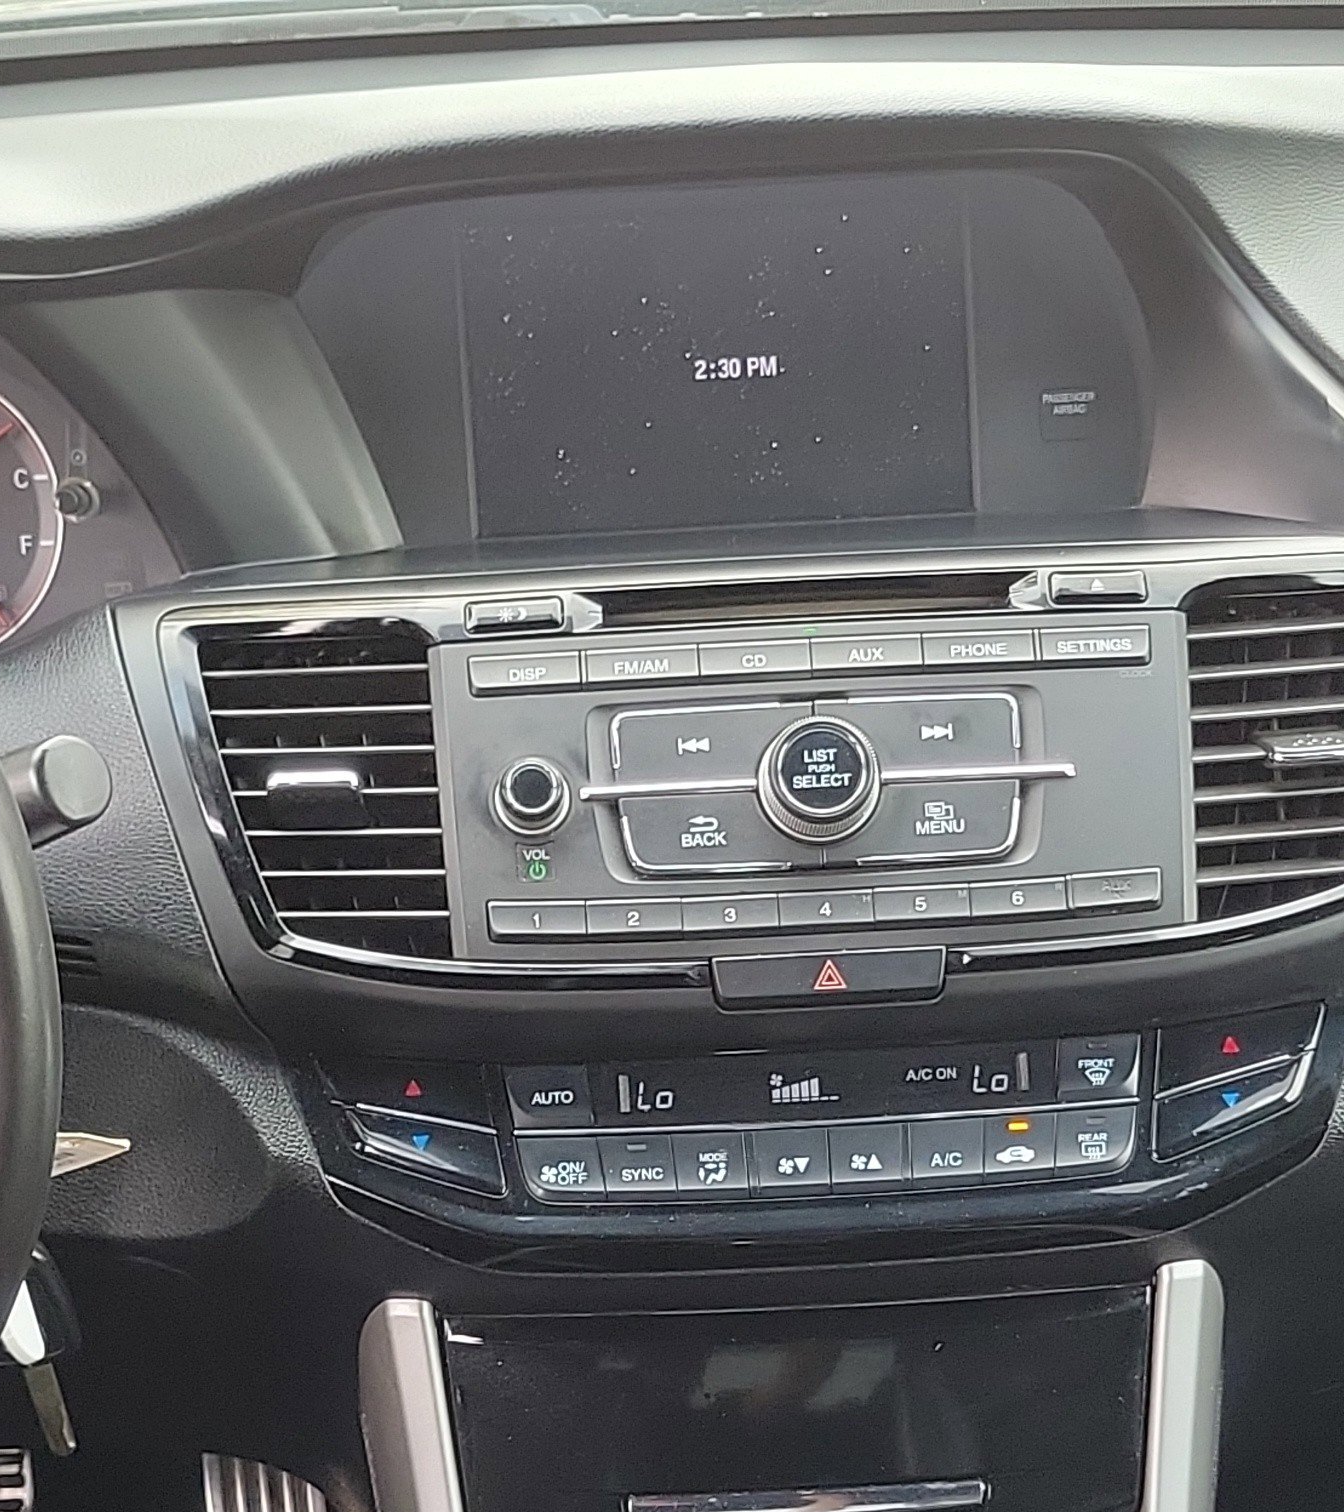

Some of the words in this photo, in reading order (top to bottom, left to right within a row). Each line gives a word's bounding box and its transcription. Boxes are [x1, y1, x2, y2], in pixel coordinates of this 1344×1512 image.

[694, 357, 741, 380] 2:30
[746, 355, 777, 378] PM
[13, 468, 30, 490] C
[18, 534, 34, 556] F
[950, 642, 1008, 658] PHONE
[1056, 637, 1133, 654] SETTINGS
[741, 653, 767, 669] CD
[848, 647, 884, 663] AUX
[508, 666, 547, 682] DISP
[613, 658, 670, 675] FM/AM
[803, 748, 837, 763] LIST
[808, 763, 836, 774] PUSH
[792, 773, 853, 790] SELECT
[915, 818, 965, 836] MENU
[681, 830, 727, 848] BACK
[522, 849, 551, 862] VOL
[915, 896, 927, 912] 5
[1011, 890, 1025, 906] 6
[723, 906, 738, 923] 3
[819, 902, 832, 918] 4
[532, 913, 542, 928] 1
[626, 912, 640, 928] 2
[1077, 1058, 1116, 1069] FRONT
[905, 1067, 933, 1082] A/C
[935, 1066, 957, 1080] ON
[531, 1090, 575, 1106] AUTO
[1077, 1133, 1109, 1143] REAR
[698, 1152, 728, 1163] MODE
[930, 1152, 963, 1168] A/C
[557, 1161, 586, 1175] ON/
[621, 1167, 666, 1182] SYNC
[557, 1172, 588, 1186] OFF
